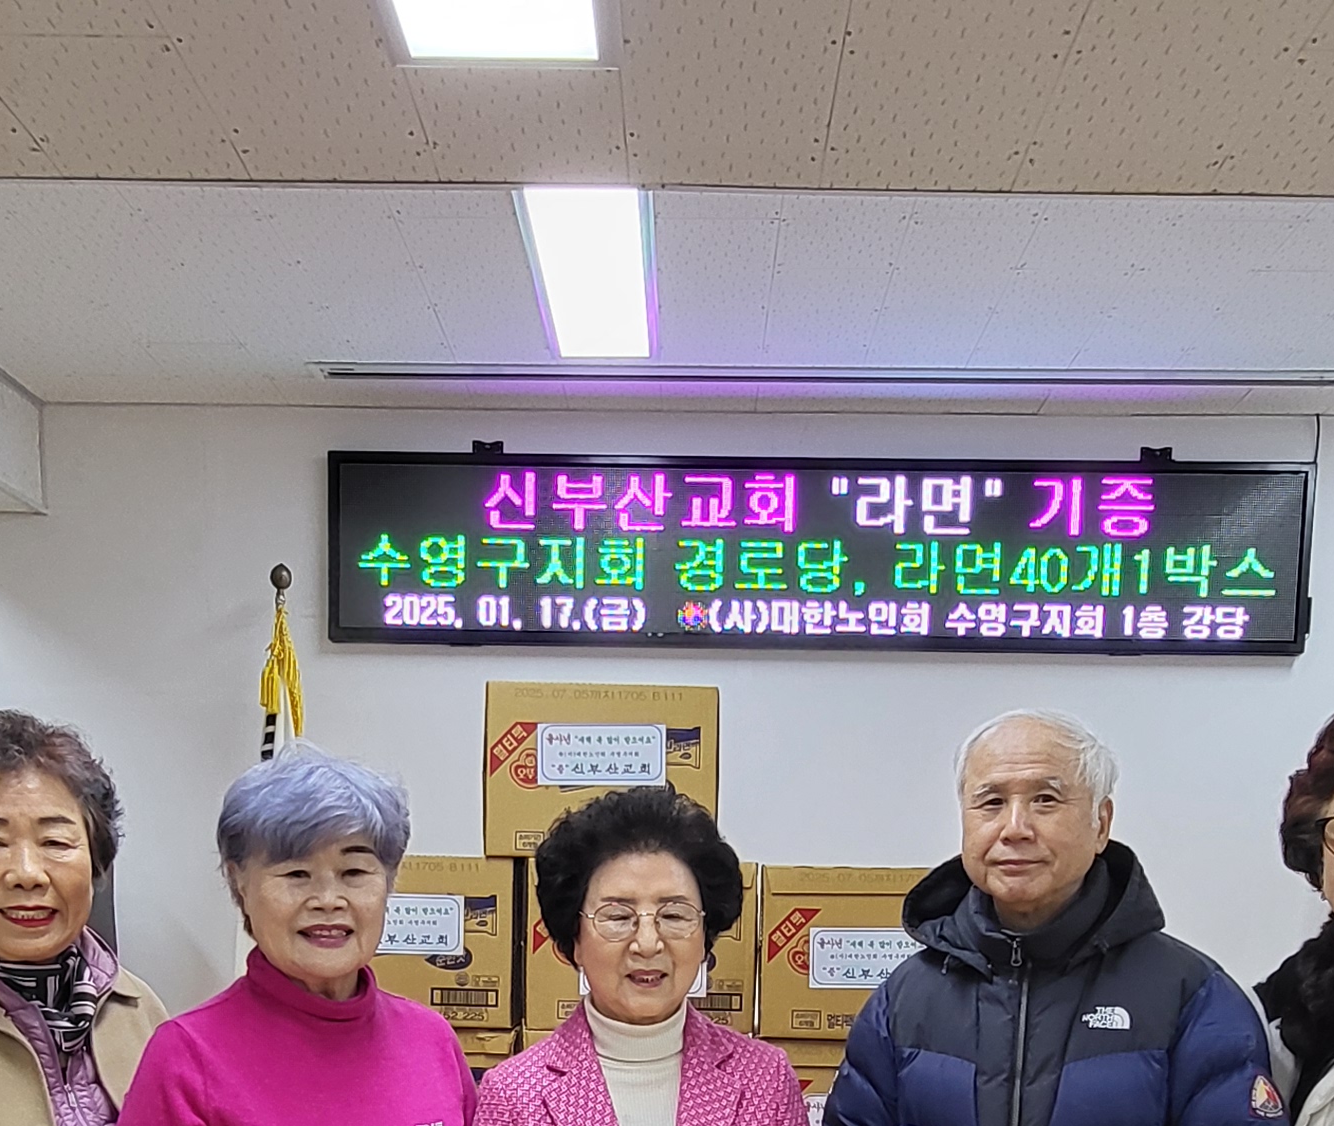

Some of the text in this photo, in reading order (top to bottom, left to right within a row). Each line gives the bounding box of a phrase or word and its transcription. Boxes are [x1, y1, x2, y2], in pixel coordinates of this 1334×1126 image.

[483, 471, 1156, 539] 신부산교회 "라면" 기증
[357, 533, 1276, 598] 수영구지회 경로당, 라면40개1박스
[383, 593, 1251, 640] 2025. 01. 17.(금) (사)대한노인회 수영구지회 1층 강당
[571, 762, 652, 775] 신부산교회
[385, 933, 448, 946] 부산교회
[842, 967, 891, 980] 신부산
[1095, 1006, 1115, 1014] THE
[1081, 1013, 1114, 1022] NORTH
